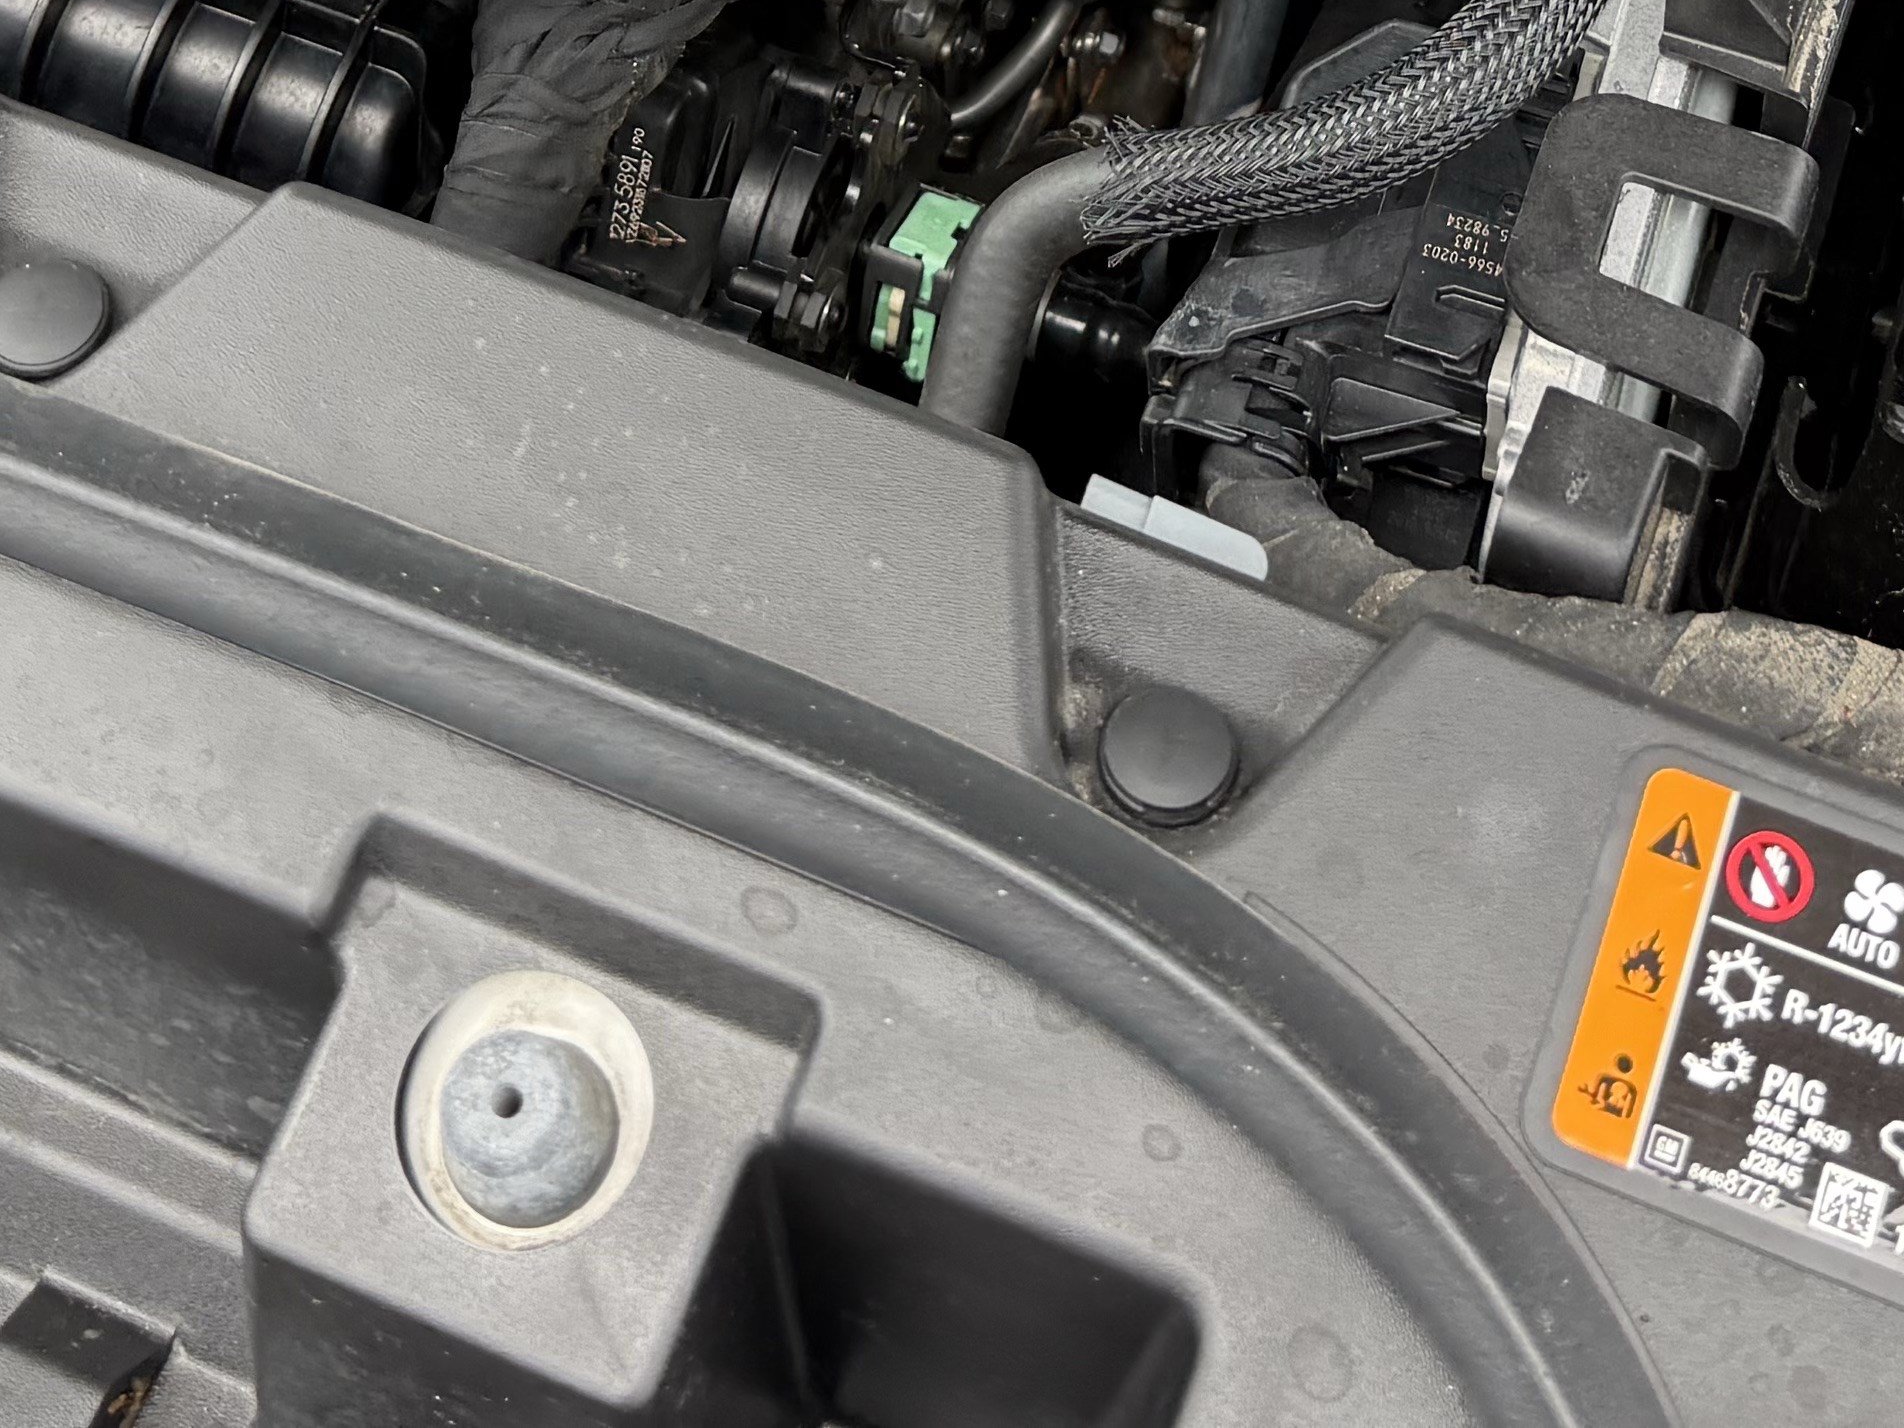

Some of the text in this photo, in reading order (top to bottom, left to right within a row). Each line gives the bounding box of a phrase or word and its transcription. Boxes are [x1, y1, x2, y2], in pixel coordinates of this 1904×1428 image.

[1828, 923, 1899, 968] AUTO
[1760, 1064, 1826, 1115] PAG
[1746, 1125, 1810, 1163] J2842
[1753, 1099, 1850, 1152] SAE J639
[1739, 1149, 1803, 1188] J2845
